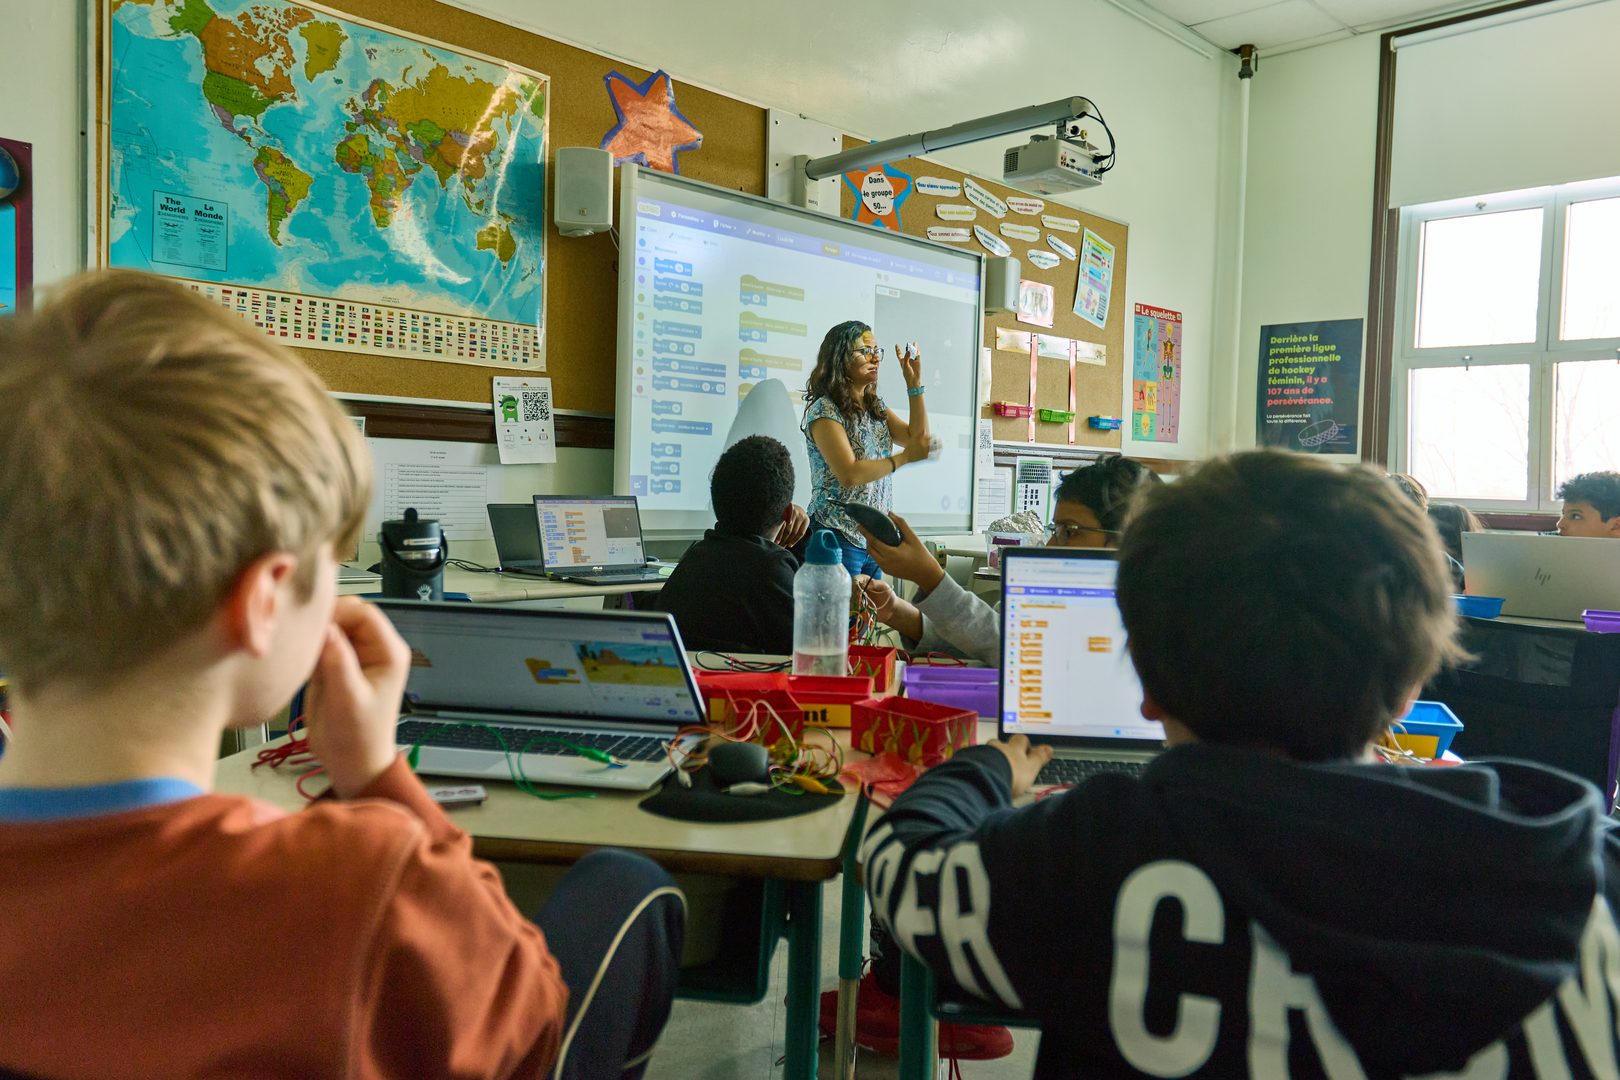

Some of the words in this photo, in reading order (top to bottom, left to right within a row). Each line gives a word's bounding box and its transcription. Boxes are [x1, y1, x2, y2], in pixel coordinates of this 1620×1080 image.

[870, 190, 892, 198] groupe
[165, 197, 181, 205] The
[160, 204, 186, 214] World
[194, 210, 223, 220] Monde
[1141, 305, 1149, 315] Le
[1150, 310, 1176, 321] squelette
[1270, 334, 1308, 344] Derrière
[1309, 334, 1318, 342] la
[1269, 345, 1311, 356] première
[1313, 344, 1336, 354] ligue
[1268, 354, 1341, 366] professionnelle
[1282, 366, 1315, 375] hockey
[1268, 375, 1305, 385] féminin,
[1267, 397, 1333, 407] persévérance.
